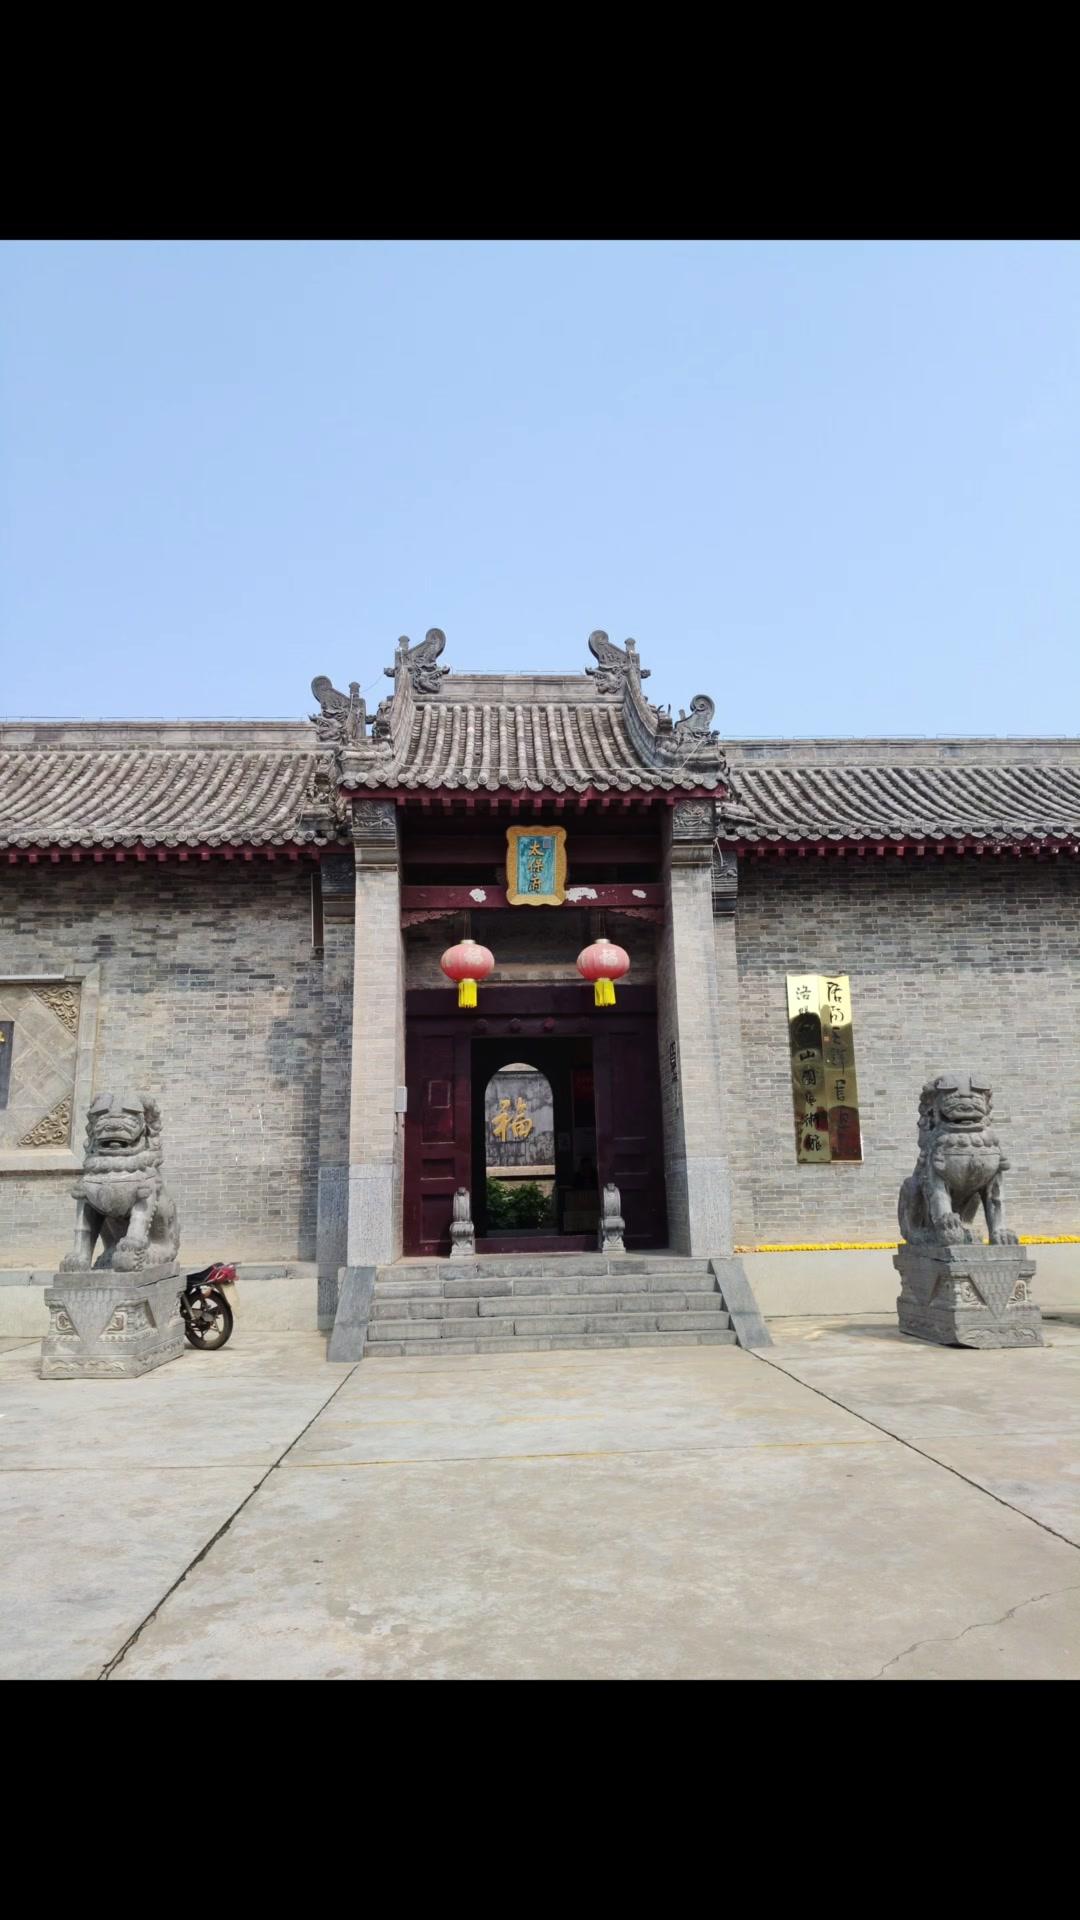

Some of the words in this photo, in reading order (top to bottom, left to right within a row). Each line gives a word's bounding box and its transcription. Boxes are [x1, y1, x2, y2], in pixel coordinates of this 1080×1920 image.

[527, 840, 545, 894] 太保府
[491, 1096, 533, 1143] 福
